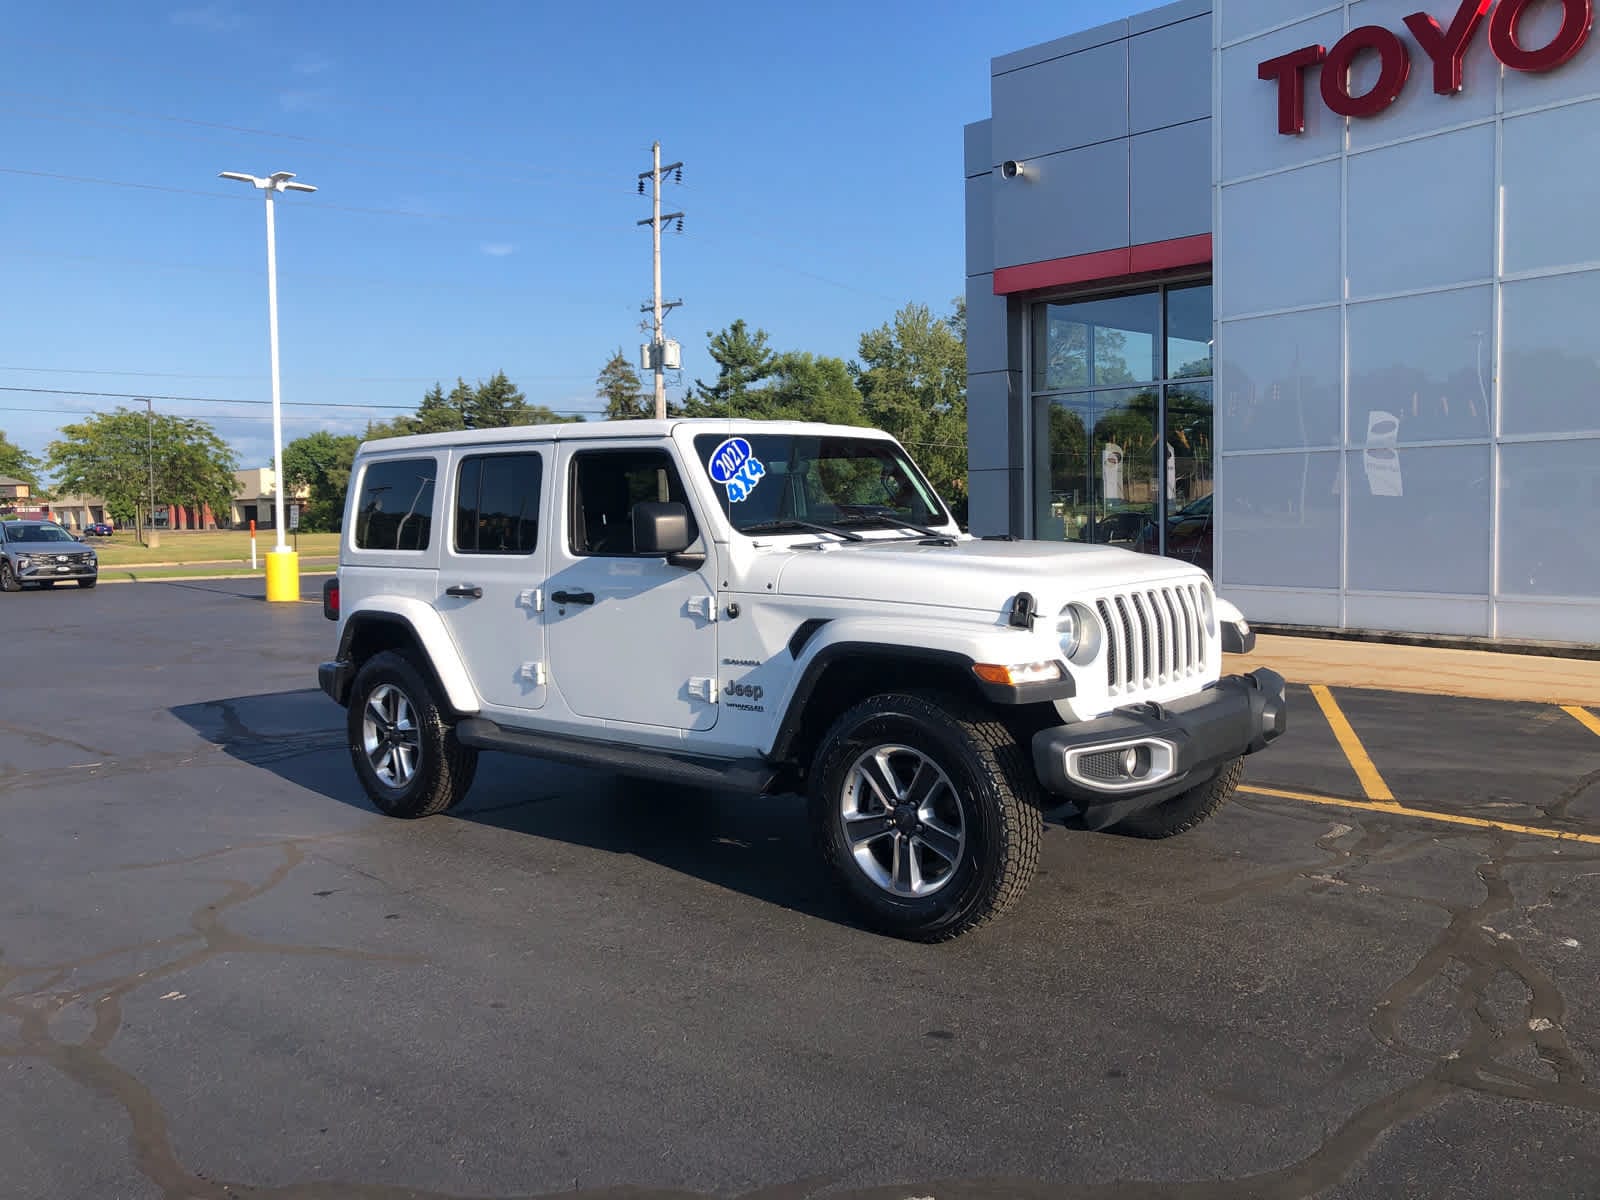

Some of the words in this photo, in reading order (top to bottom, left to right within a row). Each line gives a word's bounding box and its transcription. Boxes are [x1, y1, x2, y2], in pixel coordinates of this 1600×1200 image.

[1258, 0, 1592, 135] TOYO
[715, 441, 747, 479] 2021
[723, 679, 764, 701] Jeep
